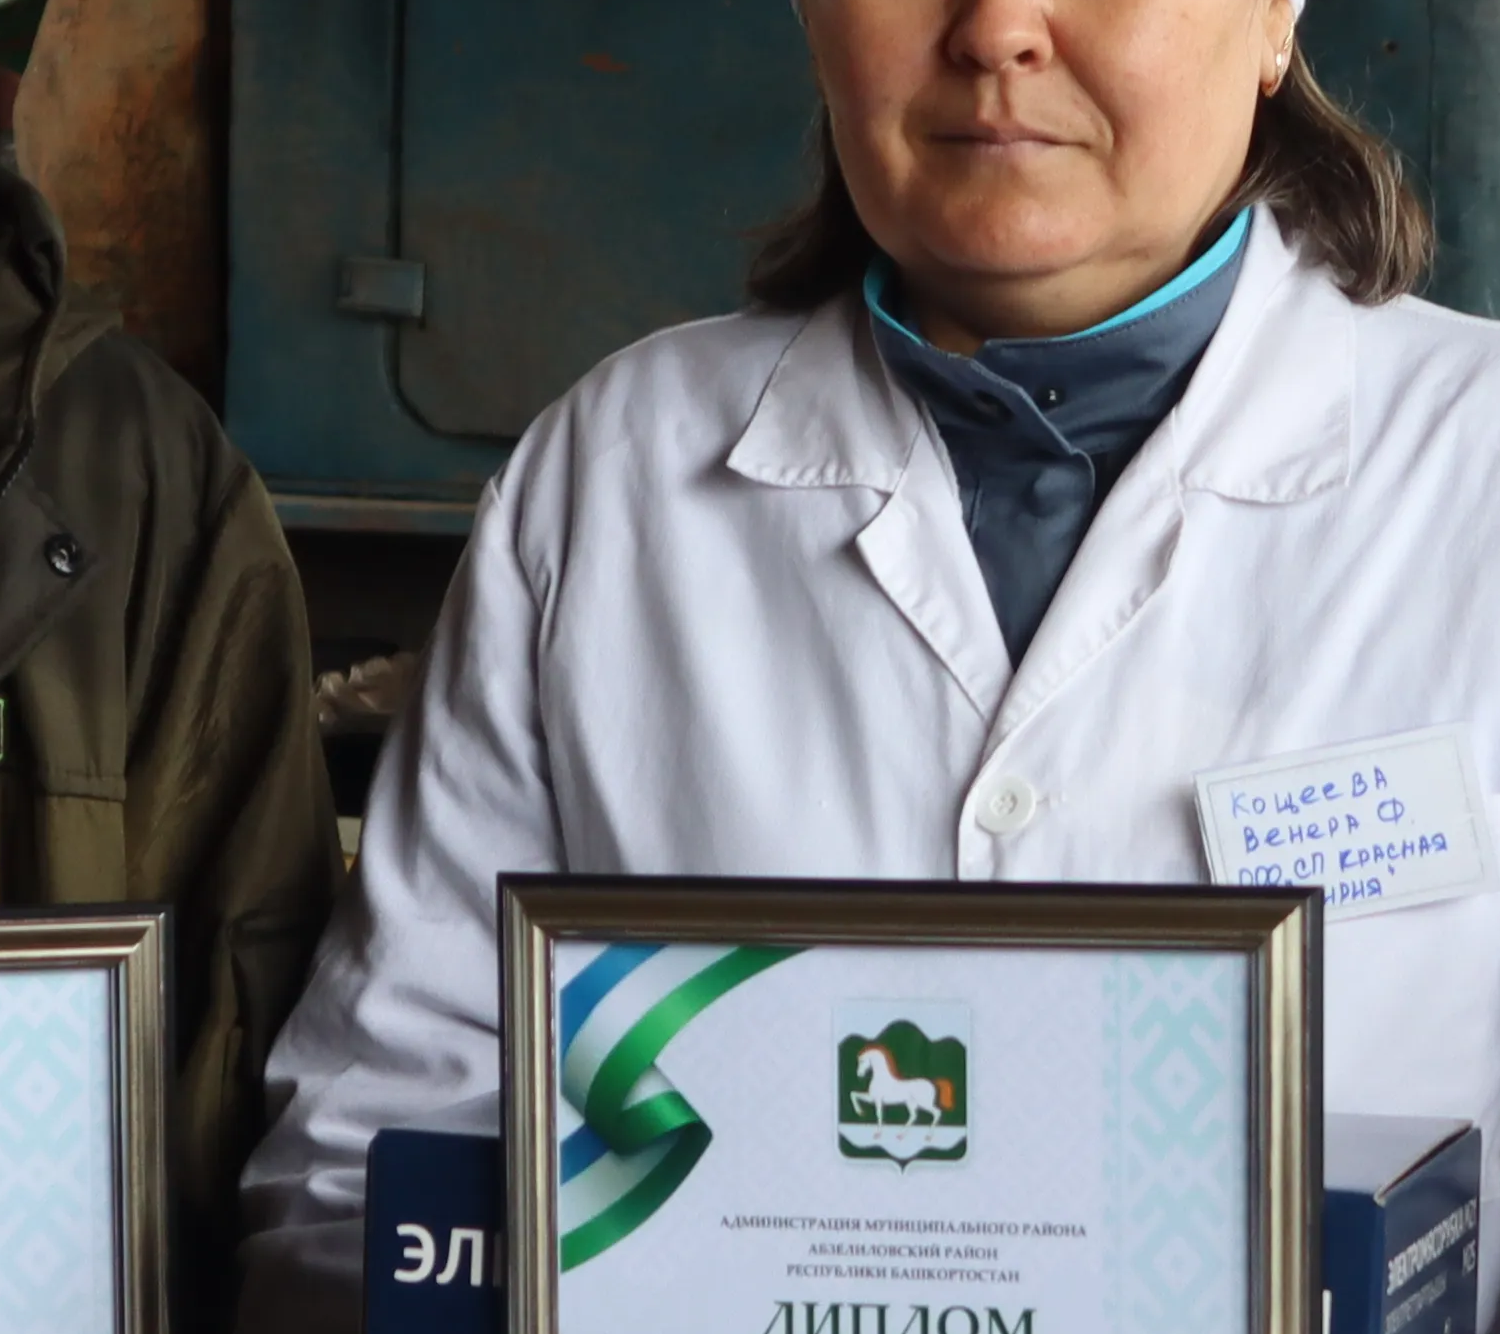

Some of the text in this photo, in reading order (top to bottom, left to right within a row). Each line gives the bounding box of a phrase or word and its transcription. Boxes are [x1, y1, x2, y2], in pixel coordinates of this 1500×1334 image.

[1339, 832, 1448, 872] КРАСНАЯ
[720, 1215, 1087, 1238] АДМИНИСТРАЦИЯ МУНИЦИПАЛЬНОГО РАЙОНА
[393, 1223, 485, 1287] ЭЛ
